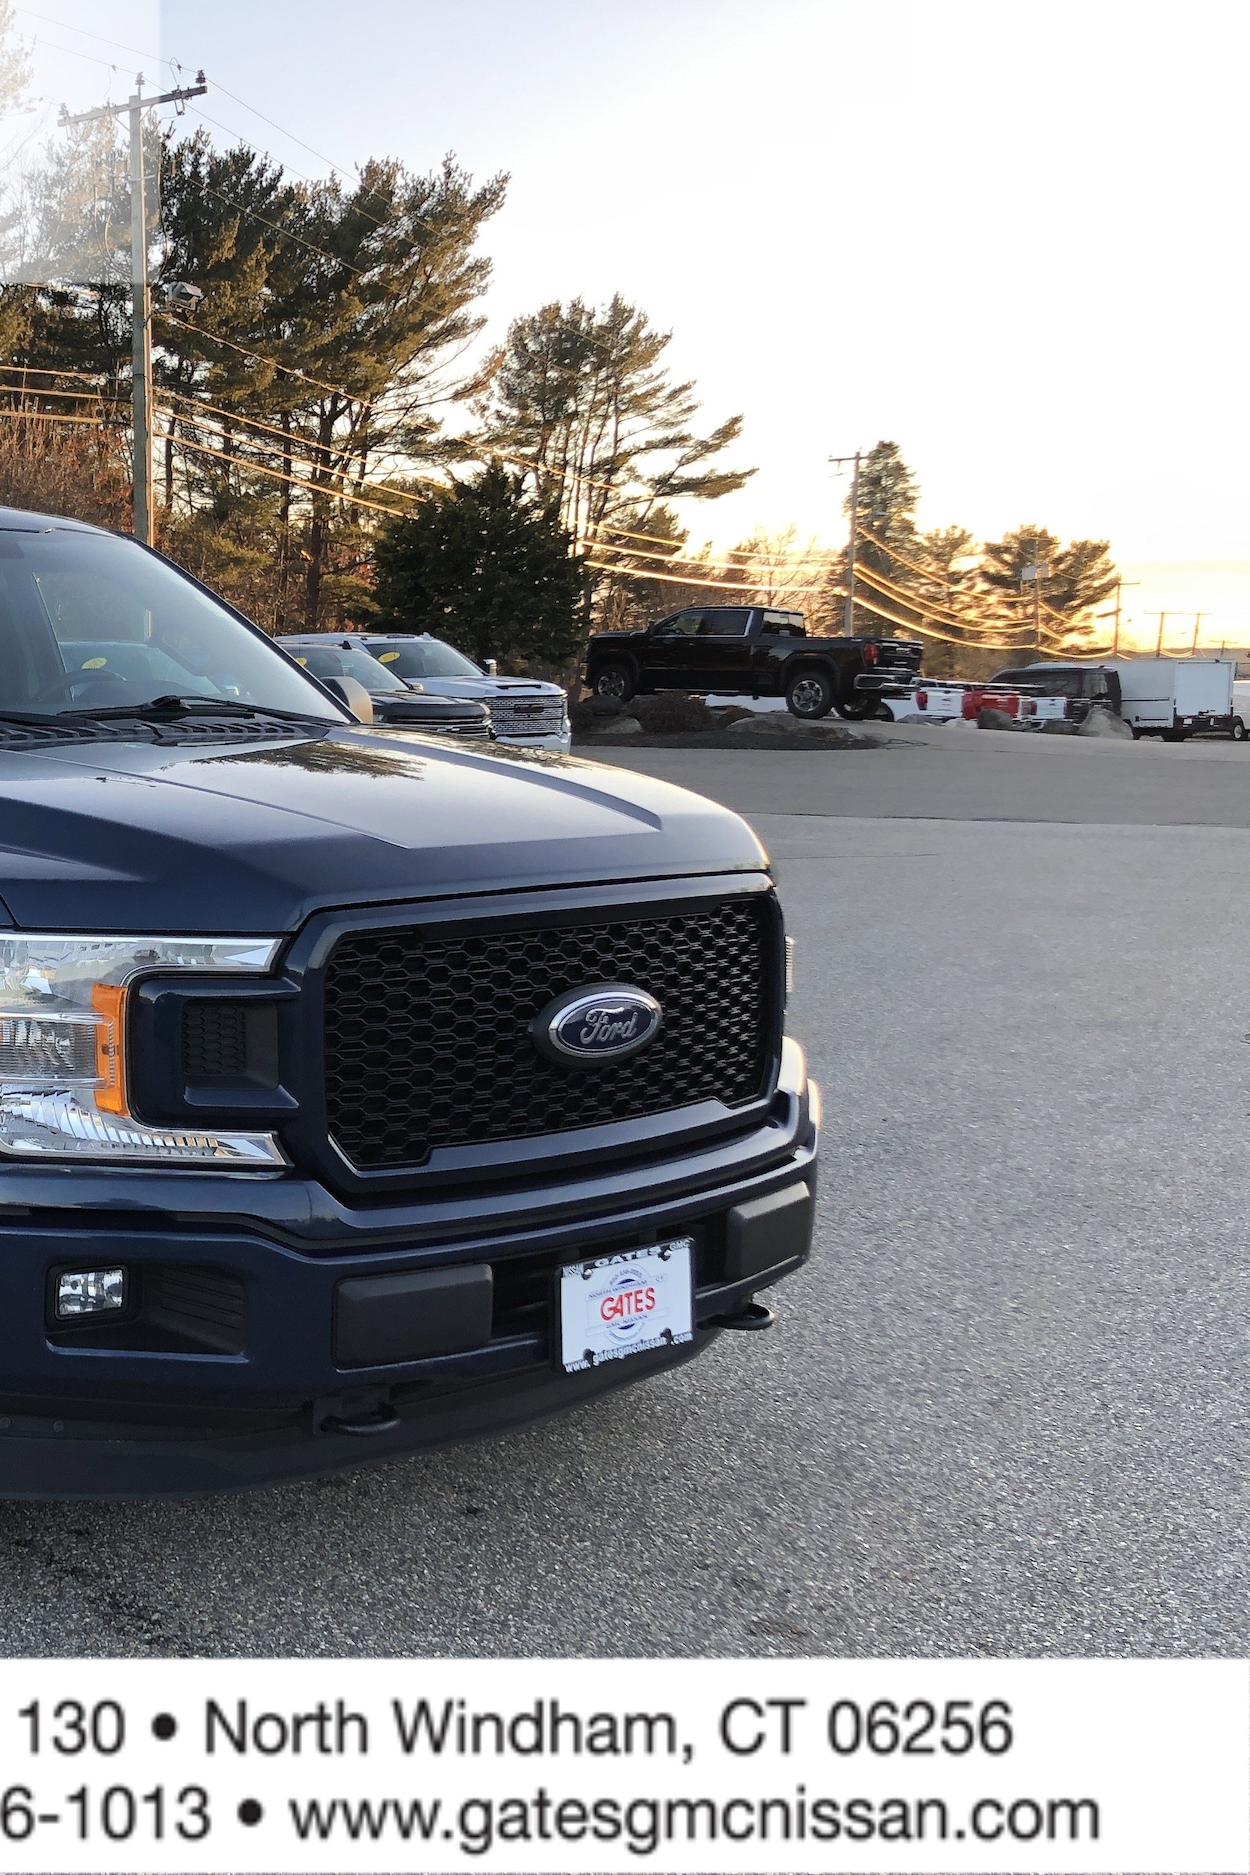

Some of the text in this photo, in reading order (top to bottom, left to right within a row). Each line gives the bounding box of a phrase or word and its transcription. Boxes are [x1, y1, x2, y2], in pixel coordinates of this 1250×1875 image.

[579, 1006, 639, 1045] Ford
[594, 1246, 662, 1268] GATES
[600, 1287, 656, 1321] GATES
